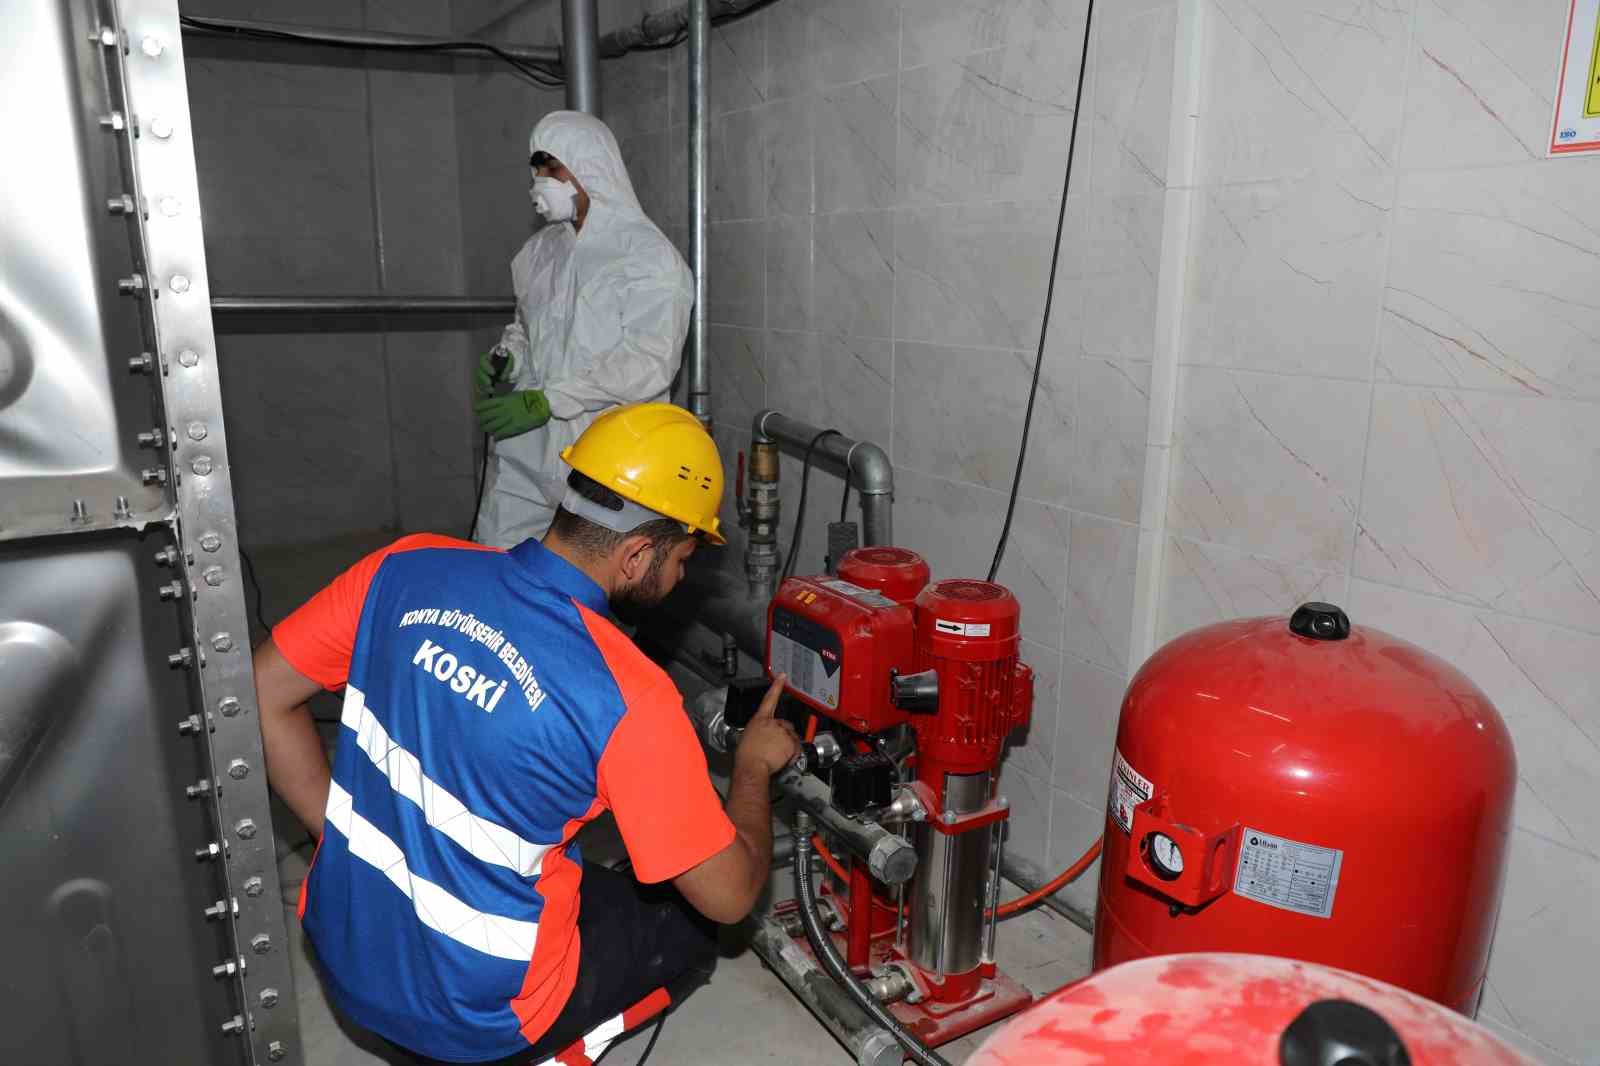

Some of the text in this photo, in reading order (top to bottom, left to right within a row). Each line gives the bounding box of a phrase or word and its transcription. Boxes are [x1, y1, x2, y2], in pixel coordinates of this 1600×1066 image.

[399, 608, 548, 713] KONYA BÜYÜKŞEHİR BELEDİYESİ
[412, 639, 508, 713] KOSKİ
